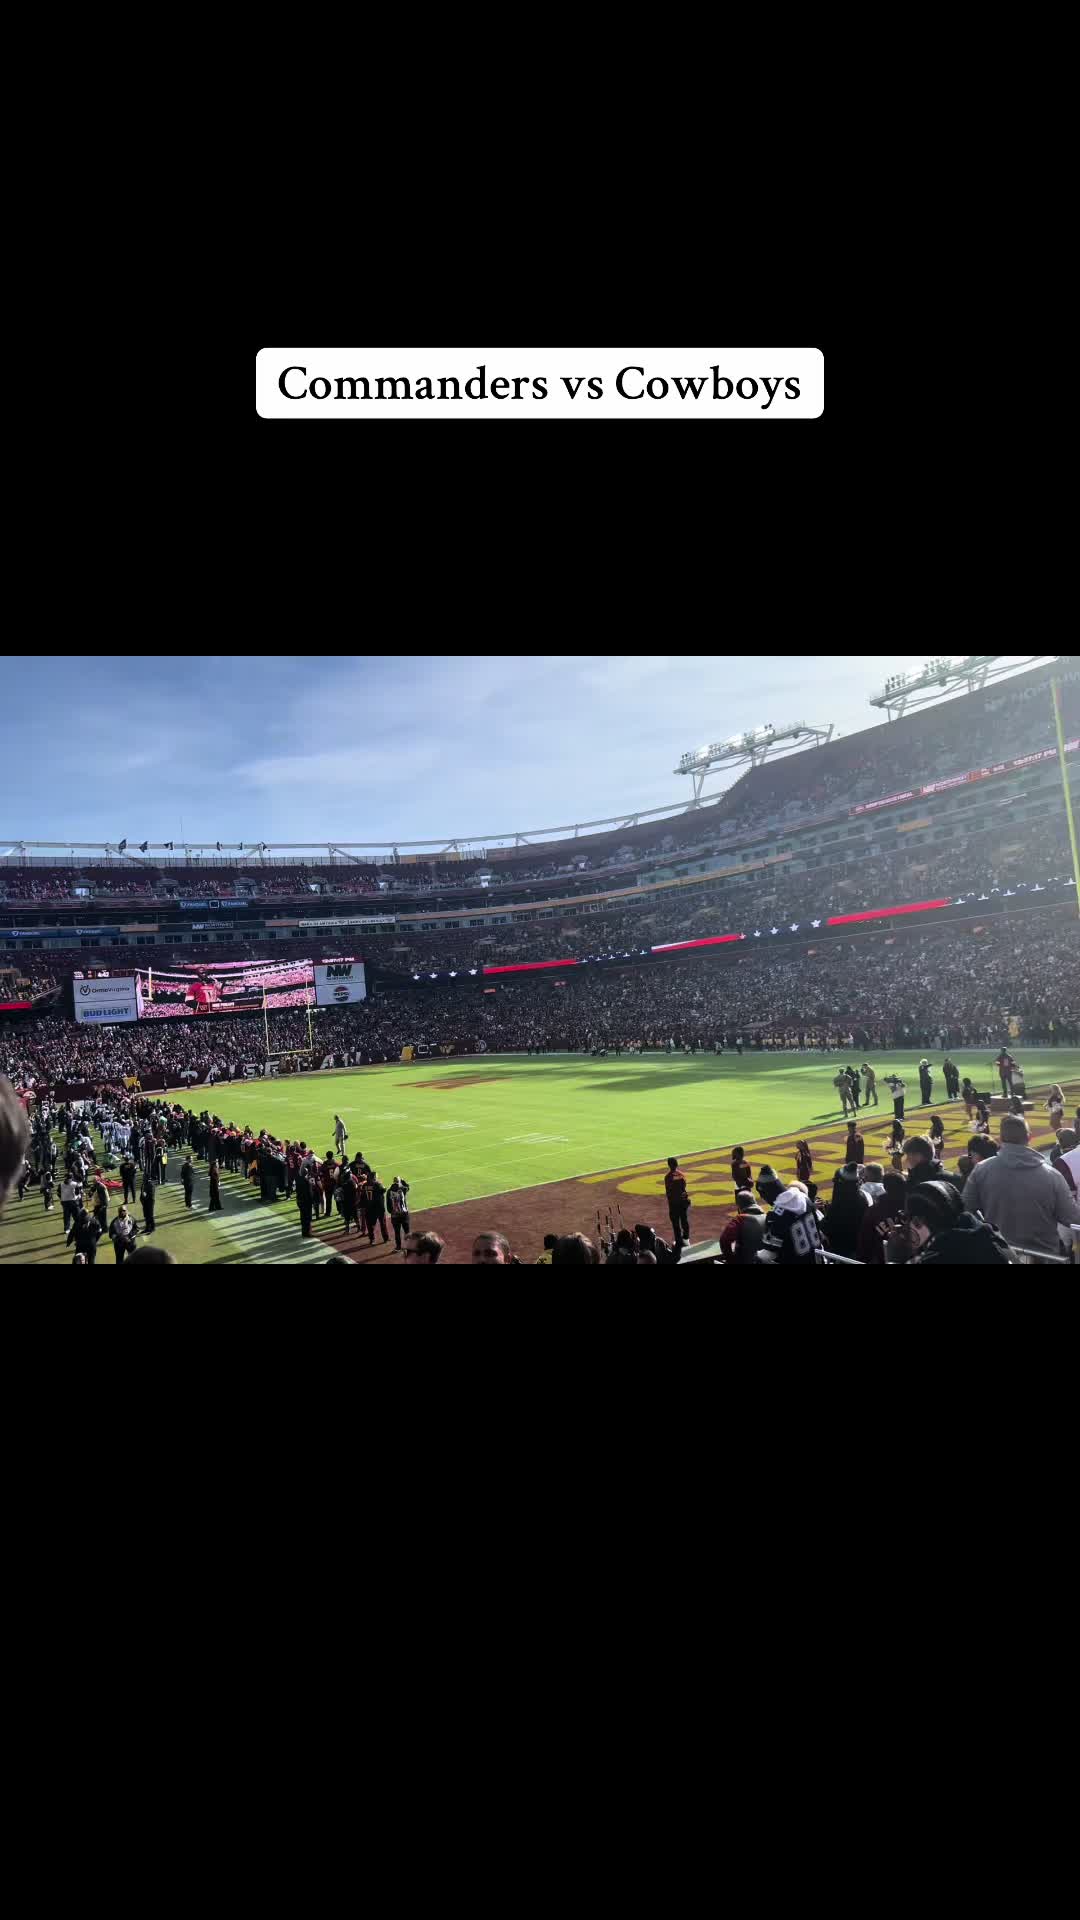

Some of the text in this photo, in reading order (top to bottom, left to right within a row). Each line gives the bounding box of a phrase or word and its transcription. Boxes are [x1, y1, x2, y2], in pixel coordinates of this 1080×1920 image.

[83, 1007, 129, 1017] BUD LIGHT
[791, 1213, 821, 1256] 88
